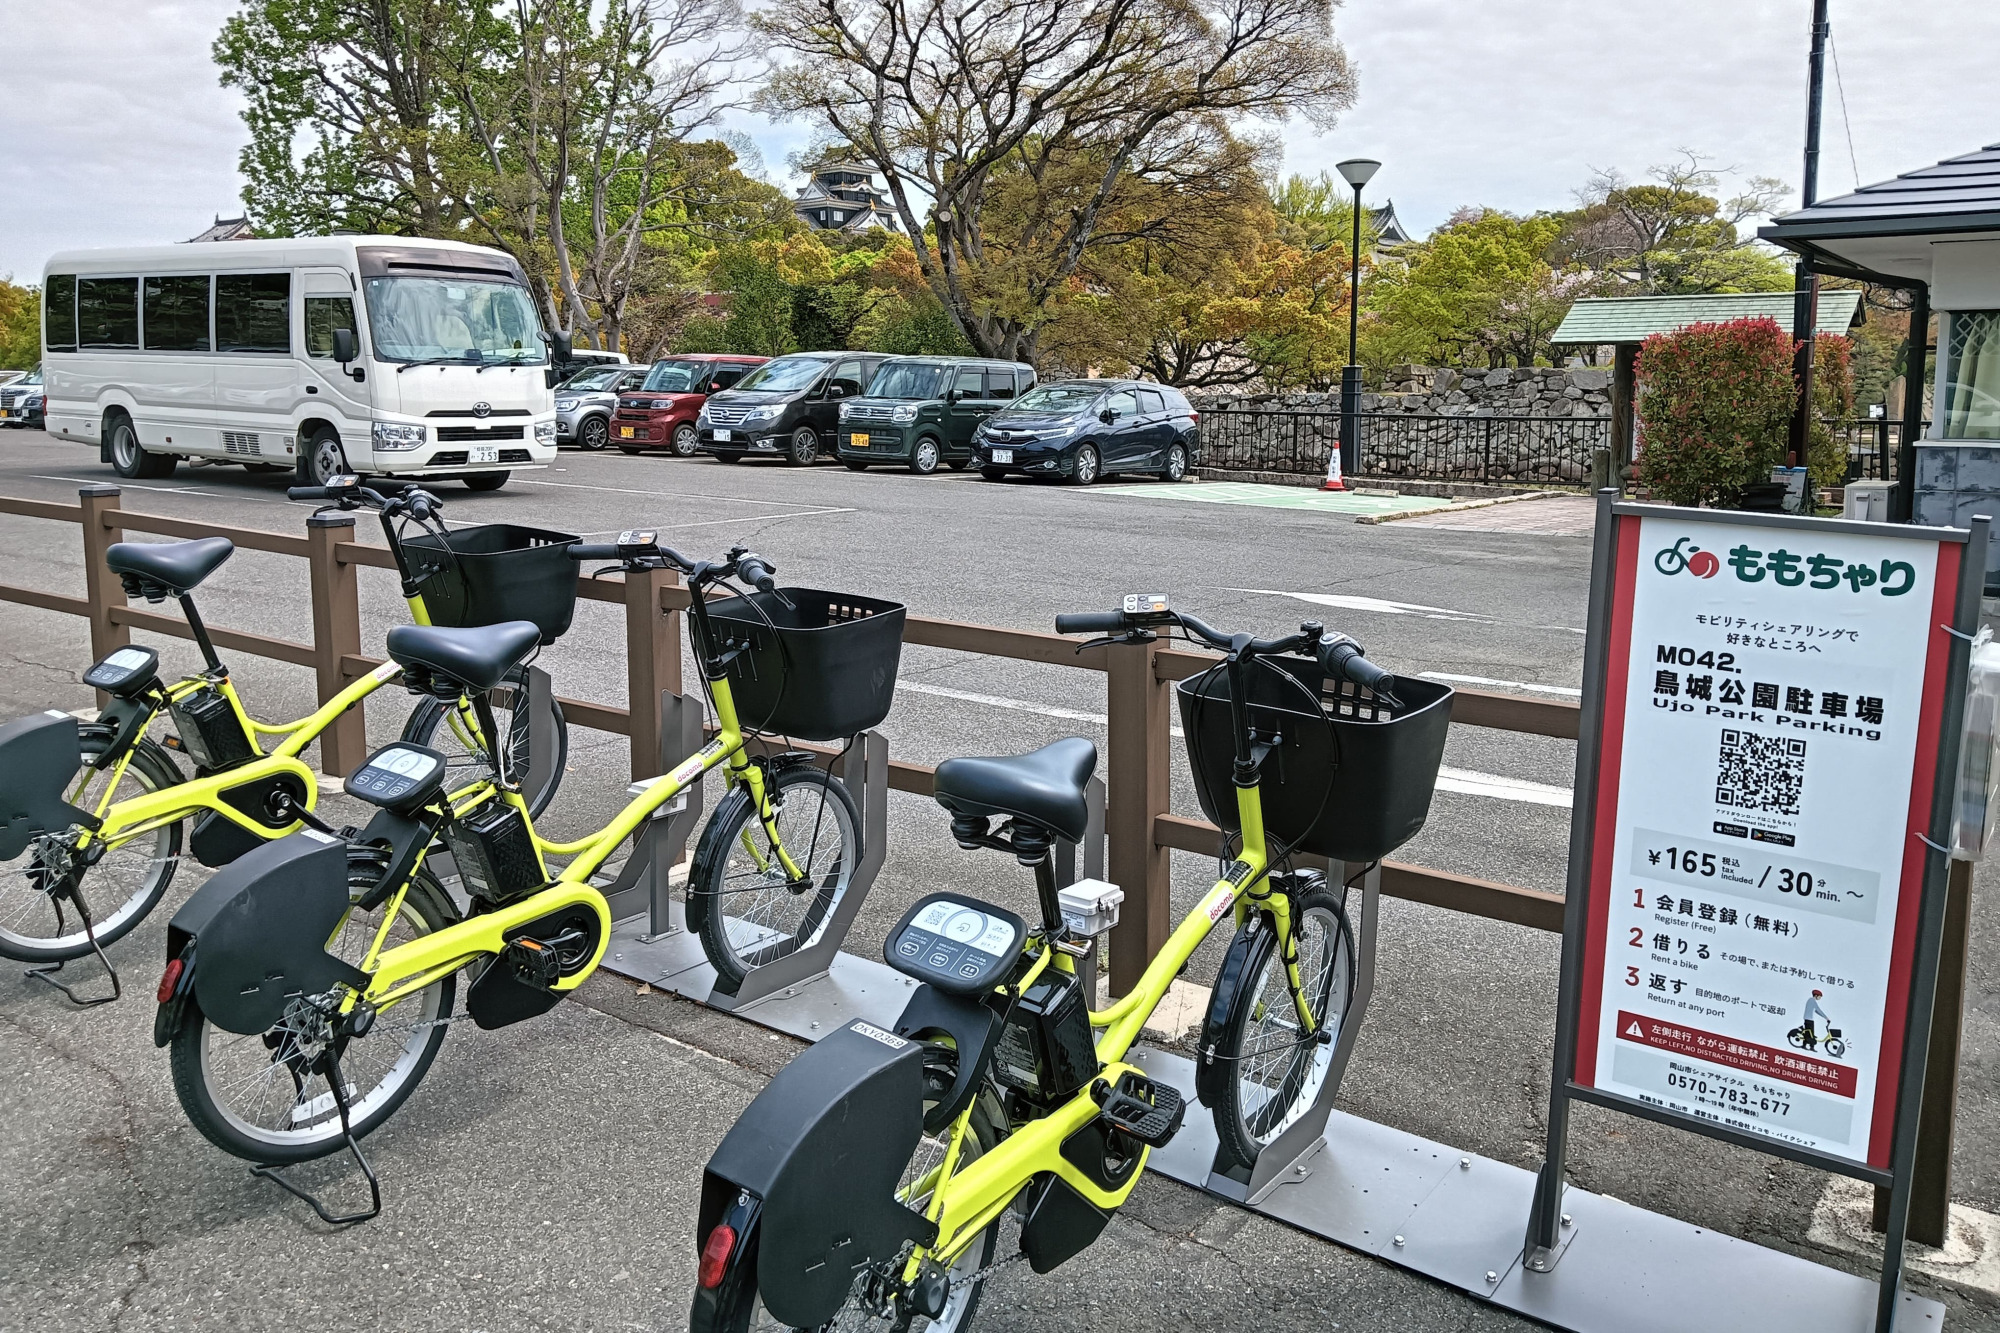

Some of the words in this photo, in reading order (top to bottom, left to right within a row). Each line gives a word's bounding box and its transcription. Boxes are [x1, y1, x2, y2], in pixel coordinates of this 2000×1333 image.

[1727, 544, 1916, 597] ももちゃり
[1696, 614, 1859, 642] モビリティシェアリングで
[1726, 633, 1822, 653] 好きなところへ
[1653, 697, 1695, 712] Ujo
[1706, 705, 1764, 723] Park
[1776, 714, 1881, 741] Parking
[677, 761, 703, 783] docomo
[1764, 831, 1782, 839] Google
[1782, 833, 1793, 842] Play
[1721, 866, 1734, 874] tax
[1722, 856, 1740, 868] 税込
[1777, 868, 1813, 897] 30
[1816, 890, 1841, 902] min.
[1817, 878, 1827, 888] 分
[1209, 892, 1234, 921] docomo
[1633, 888, 1645, 909] 1
[1654, 913, 1689, 927] Register
[1691, 922, 1717, 934] (Free)
[1628, 927, 1644, 948] 2
[1652, 932, 1711, 960] 借りる
[1651, 953, 1670, 964] Rent
[1680, 960, 1699, 971] bike
[1624, 965, 1640, 987] 3
[1648, 972, 1688, 994] 返す
[1695, 987, 1786, 1016] 目的地のポートで返却
[1647, 992, 1676, 1006] Return
[1677, 1000, 1687, 1009] at
[1688, 1004, 1705, 1015] any
[1706, 1007, 1725, 1018] port
[1650, 1036, 1668, 1045] KEEP
[1696, 1048, 1739, 1064] DISTRACTED
[1781, 1069, 1807, 1081] DRUNK
[1808, 1076, 1838, 1089] DRIVING
[1651, 1024, 1692, 1043] 左側走行
[1696, 1035, 1769, 1062] ながら運転禁止
[1773, 1054, 1839, 1079] 飲酒運転禁止
[1667, 1072, 1791, 1116] 0570-783-677
[1669, 1062, 1745, 1087] 岡山市シェアサイクル
[1752, 1084, 1791, 1099] ももちゃり
